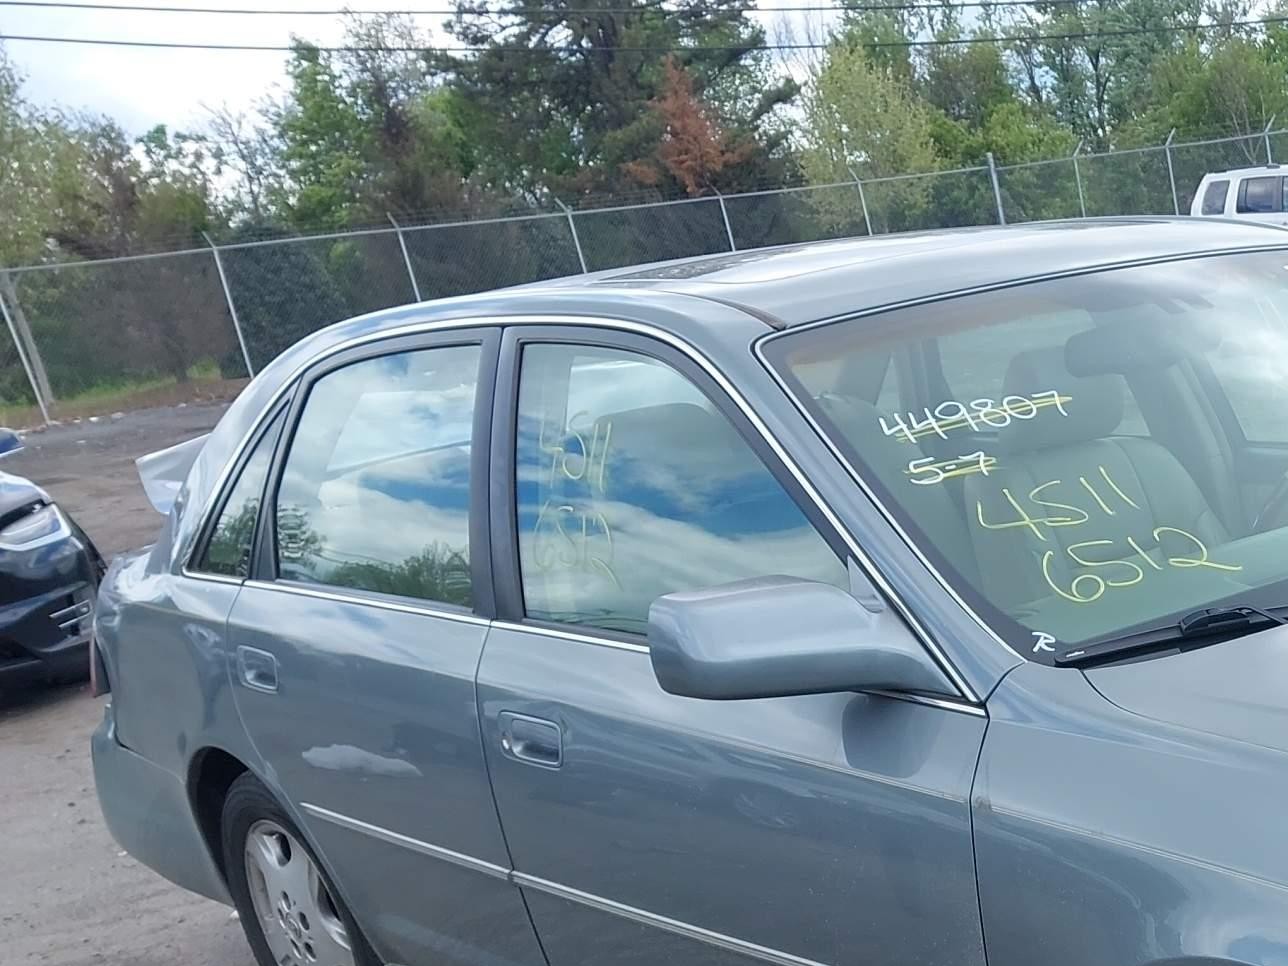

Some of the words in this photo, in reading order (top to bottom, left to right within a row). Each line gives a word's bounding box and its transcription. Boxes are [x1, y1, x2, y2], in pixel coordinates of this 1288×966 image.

[878, 390, 1070, 444] 449807
[907, 450, 991, 485] 5-7
[977, 465, 1141, 541] 4511
[1042, 526, 1243, 603] 6512
[1031, 631, 1056, 652] R
